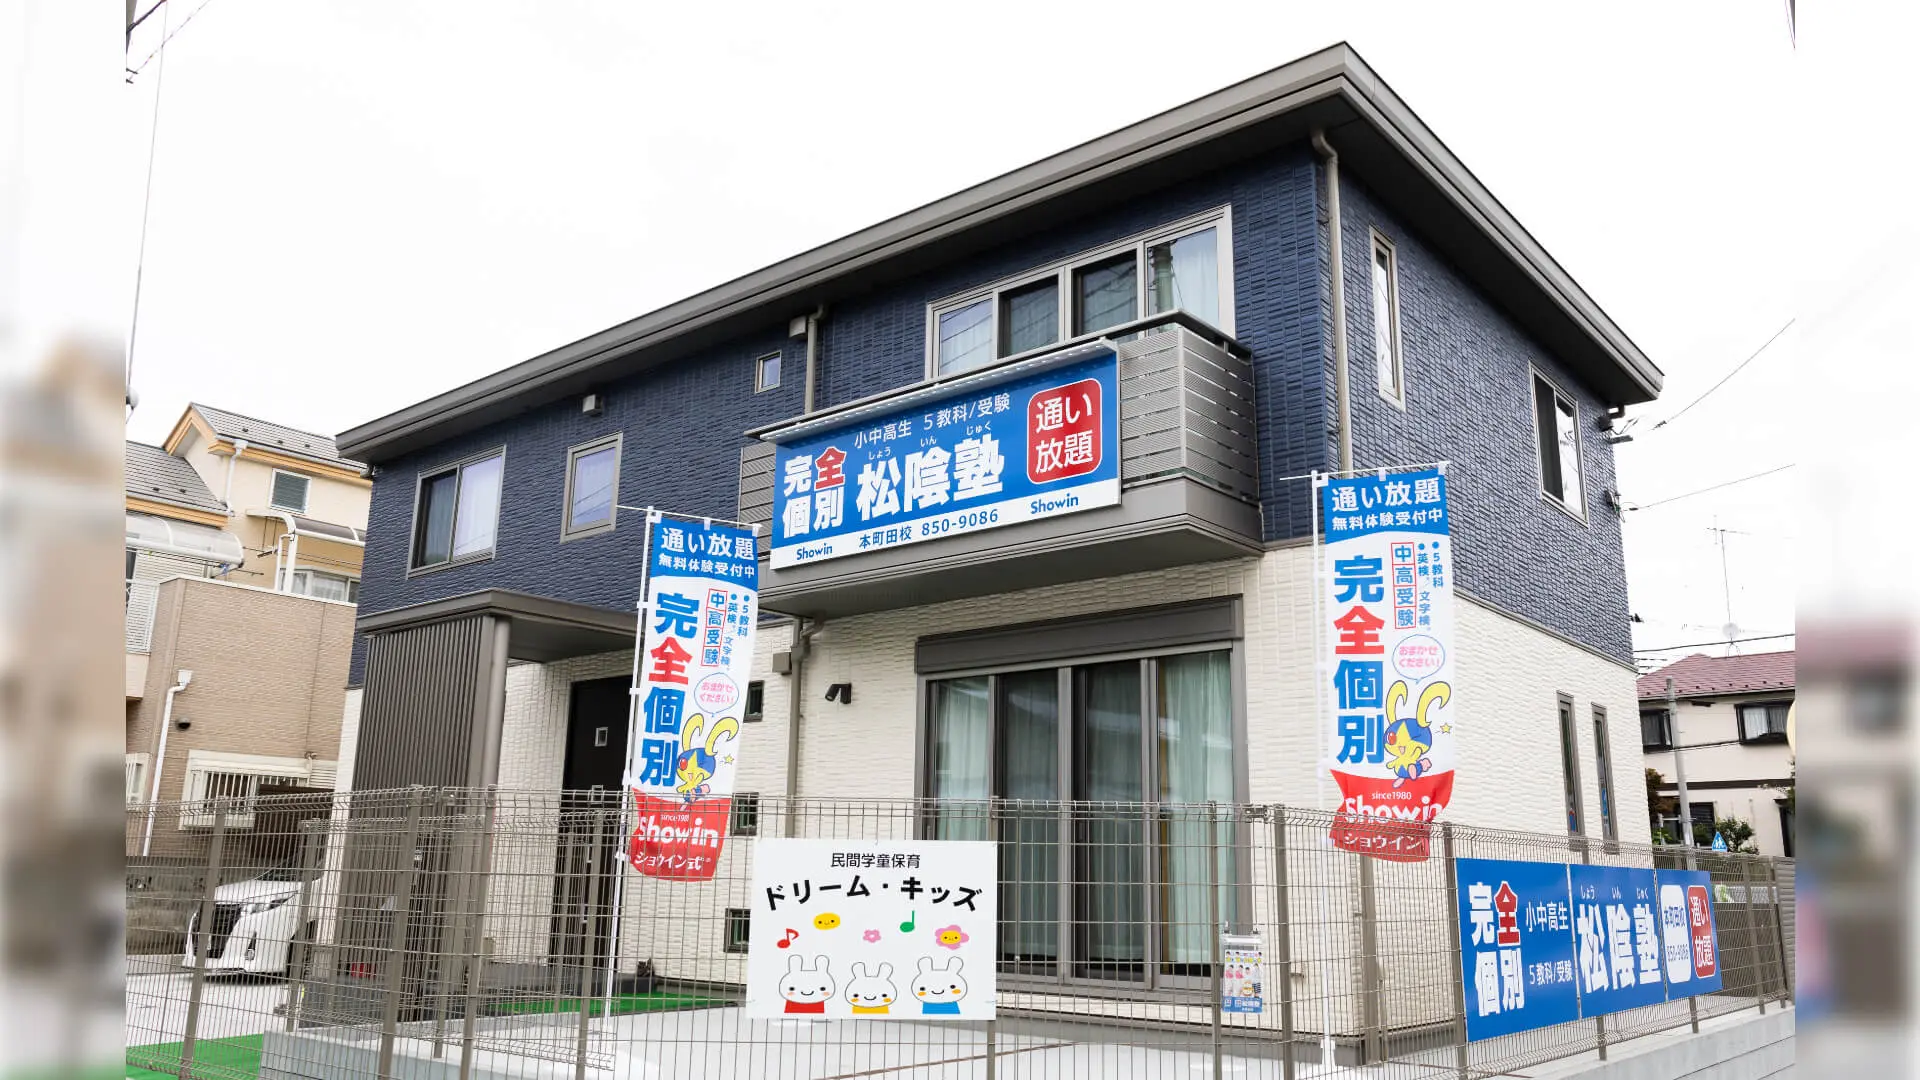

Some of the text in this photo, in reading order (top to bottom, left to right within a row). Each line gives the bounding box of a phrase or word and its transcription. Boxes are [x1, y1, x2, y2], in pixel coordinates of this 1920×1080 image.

[1035, 393, 1093, 434] 通い
[854, 420, 912, 449] 小中高生
[868, 423, 991, 460] しょう いん じゅく
[1035, 430, 1094, 475] 放題
[783, 446, 847, 497] 完全
[856, 432, 1005, 522] 松陰塾
[1030, 493, 1079, 515] Showin
[1331, 476, 1441, 512] 通い放題
[782, 486, 845, 539] 個別
[859, 508, 999, 550] 本町田校 850-9086
[1332, 508, 1443, 531] 無料体験受付中
[661, 527, 755, 561] 通い放題
[796, 542, 833, 561] Showin
[658, 553, 755, 579] 無料体験受付中
[1394, 545, 1414, 627] 中高受験
[704, 592, 725, 665] 中高受験
[1333, 555, 1385, 765] 完全個別
[1399, 646, 1438, 656] おまかせ
[639, 592, 700, 787] 完全個別
[1345, 795, 1443, 824] Showin
[1371, 791, 1412, 800] since1980
[638, 815, 719, 848] Showin
[830, 852, 921, 869] 民間学童保育
[766, 875, 983, 912] ドリーム・キッズ
[1690, 896, 1708, 927] 通い
[1468, 880, 1521, 947] 完全
[1525, 901, 1569, 933] 小中高生
[1577, 903, 1661, 994] 松陰塾
[1694, 935, 1714, 968] 放題
[1474, 947, 1525, 1017] 個別
